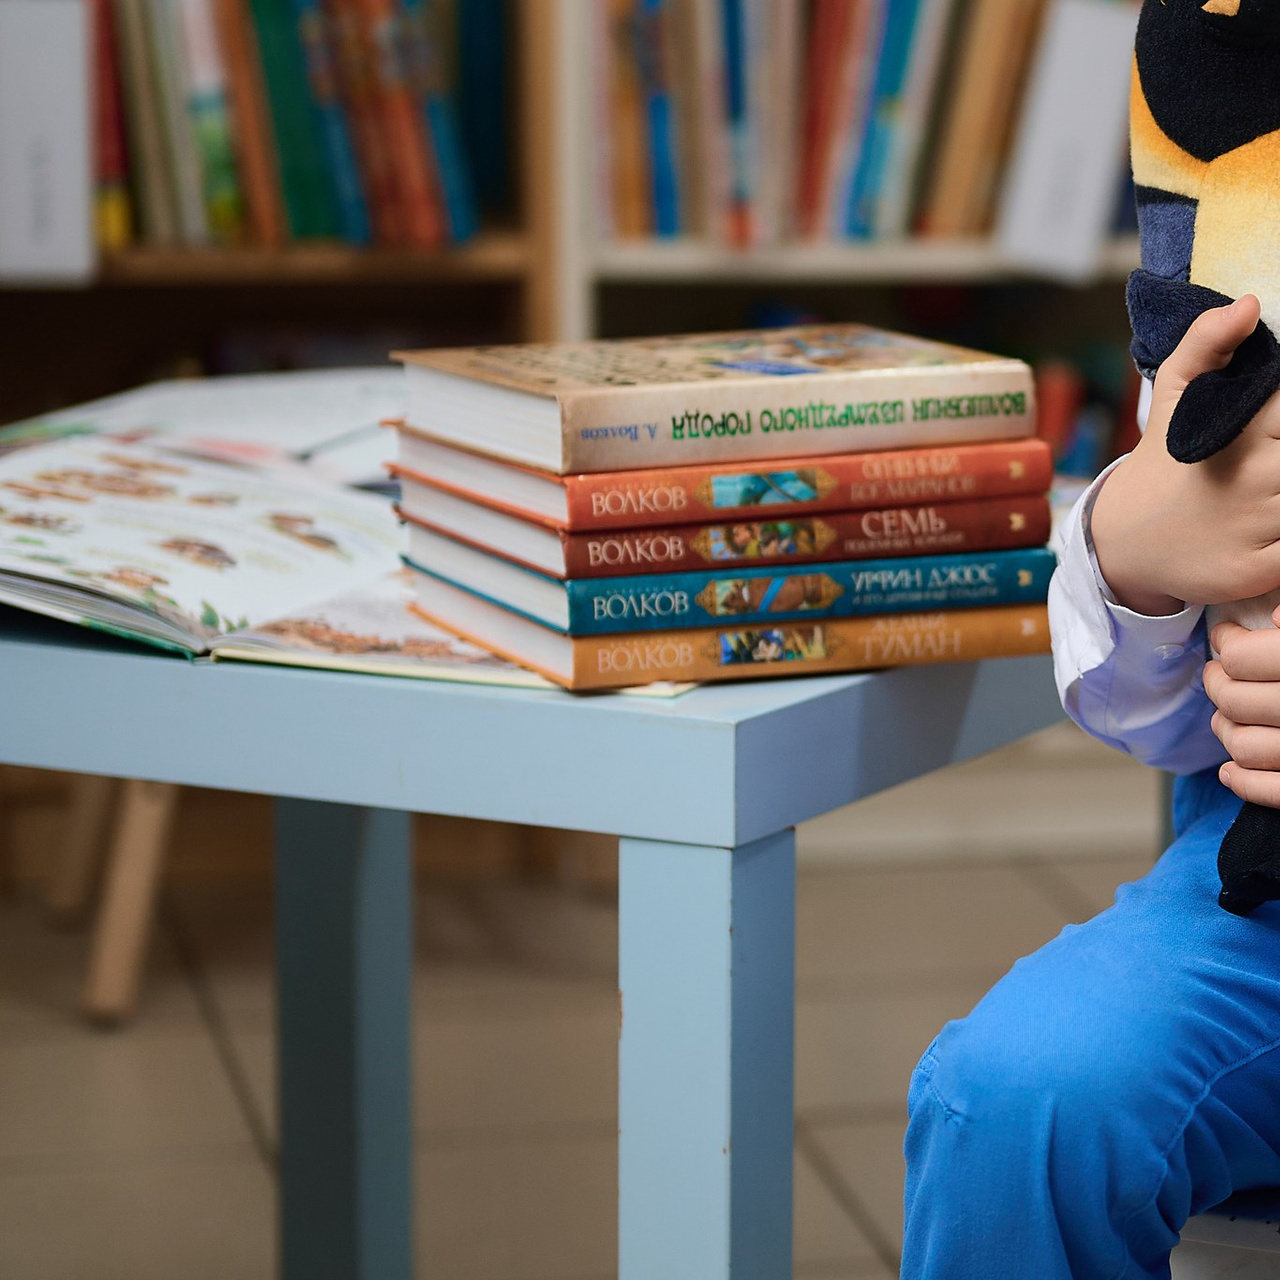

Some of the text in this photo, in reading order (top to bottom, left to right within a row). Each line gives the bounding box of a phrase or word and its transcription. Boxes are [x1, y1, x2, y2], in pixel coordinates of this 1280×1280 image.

[671, 391, 1026, 440] ВОЛШЕБНИК ИЗУМРУДНОГО ГОРОДА
[591, 485, 687, 517] ВОЛКОВ
[861, 507, 946, 539] СЕМЬ
[587, 536, 685, 567] ВОЛКОВ
[851, 568, 922, 592] УРФИН
[592, 591, 689, 621] ВОЛКОВ
[597, 643, 695, 673] ВОЛКОВ
[860, 629, 961, 662] ТУМАН
